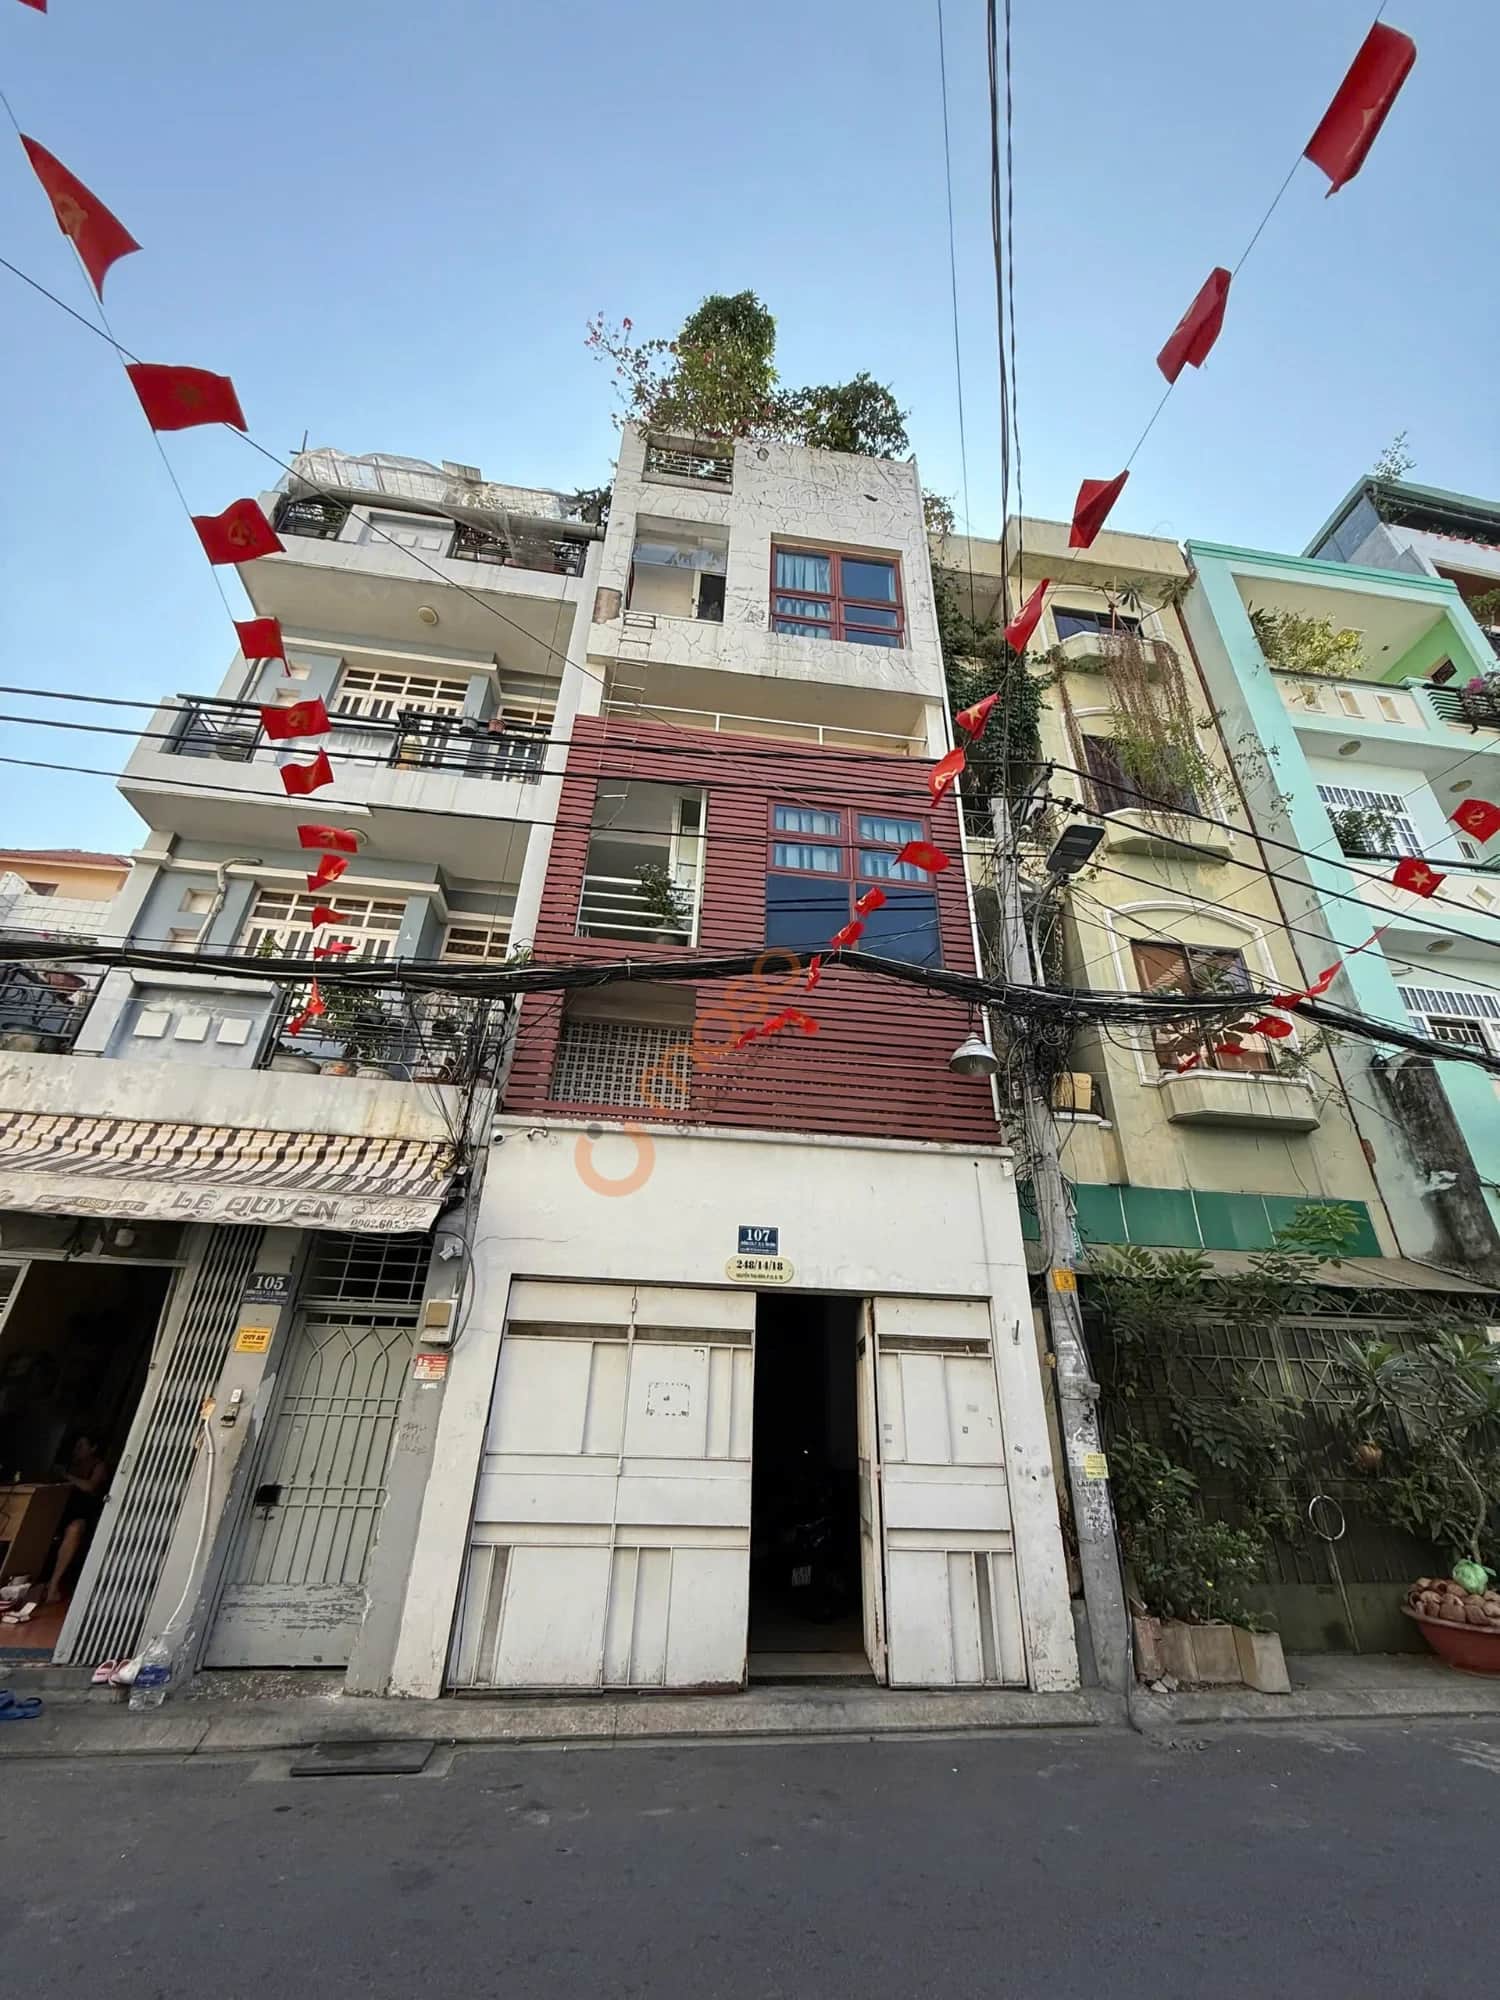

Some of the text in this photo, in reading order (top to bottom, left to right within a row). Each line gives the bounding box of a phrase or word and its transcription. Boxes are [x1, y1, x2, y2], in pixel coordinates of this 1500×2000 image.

[746, 1229, 771, 1242] 107
[736, 1260, 783, 1272] 248/14/18
[254, 1275, 286, 1290] 105
